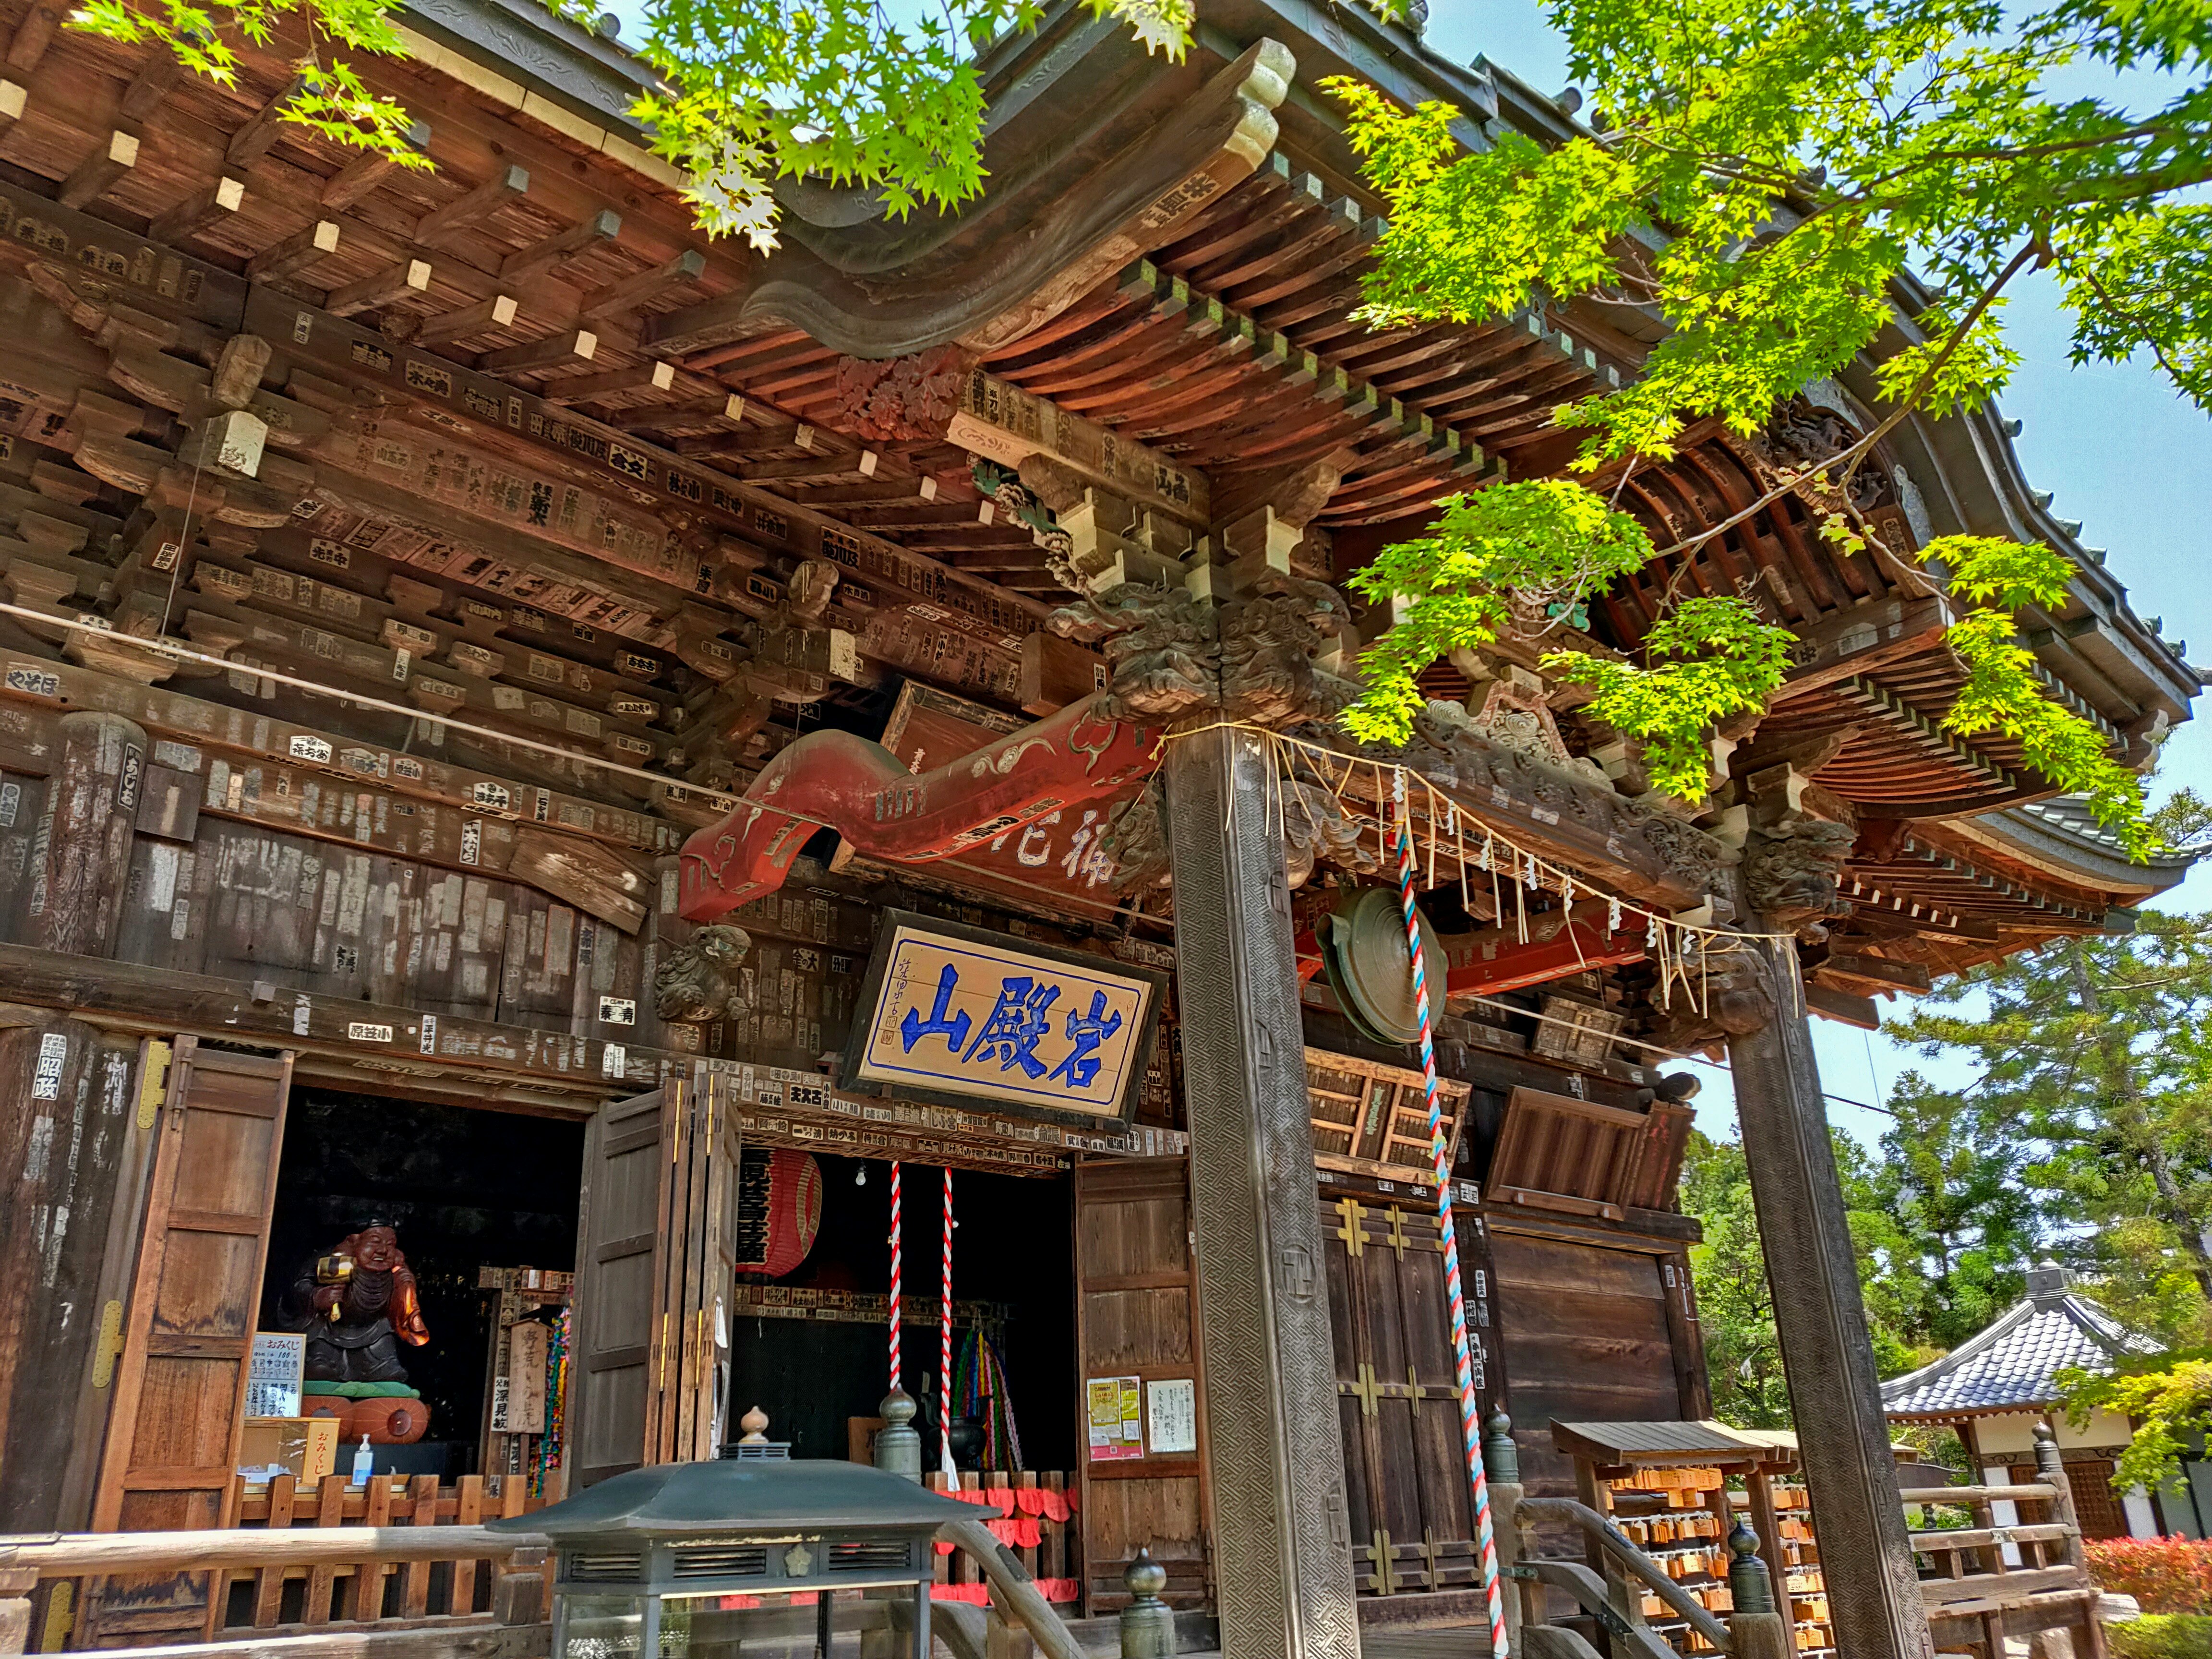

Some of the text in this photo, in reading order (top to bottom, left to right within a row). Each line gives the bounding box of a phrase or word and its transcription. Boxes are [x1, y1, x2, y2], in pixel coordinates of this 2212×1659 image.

[266, 1339, 299, 1350] おみくじ
[315, 1431, 328, 1475] おみくじ
